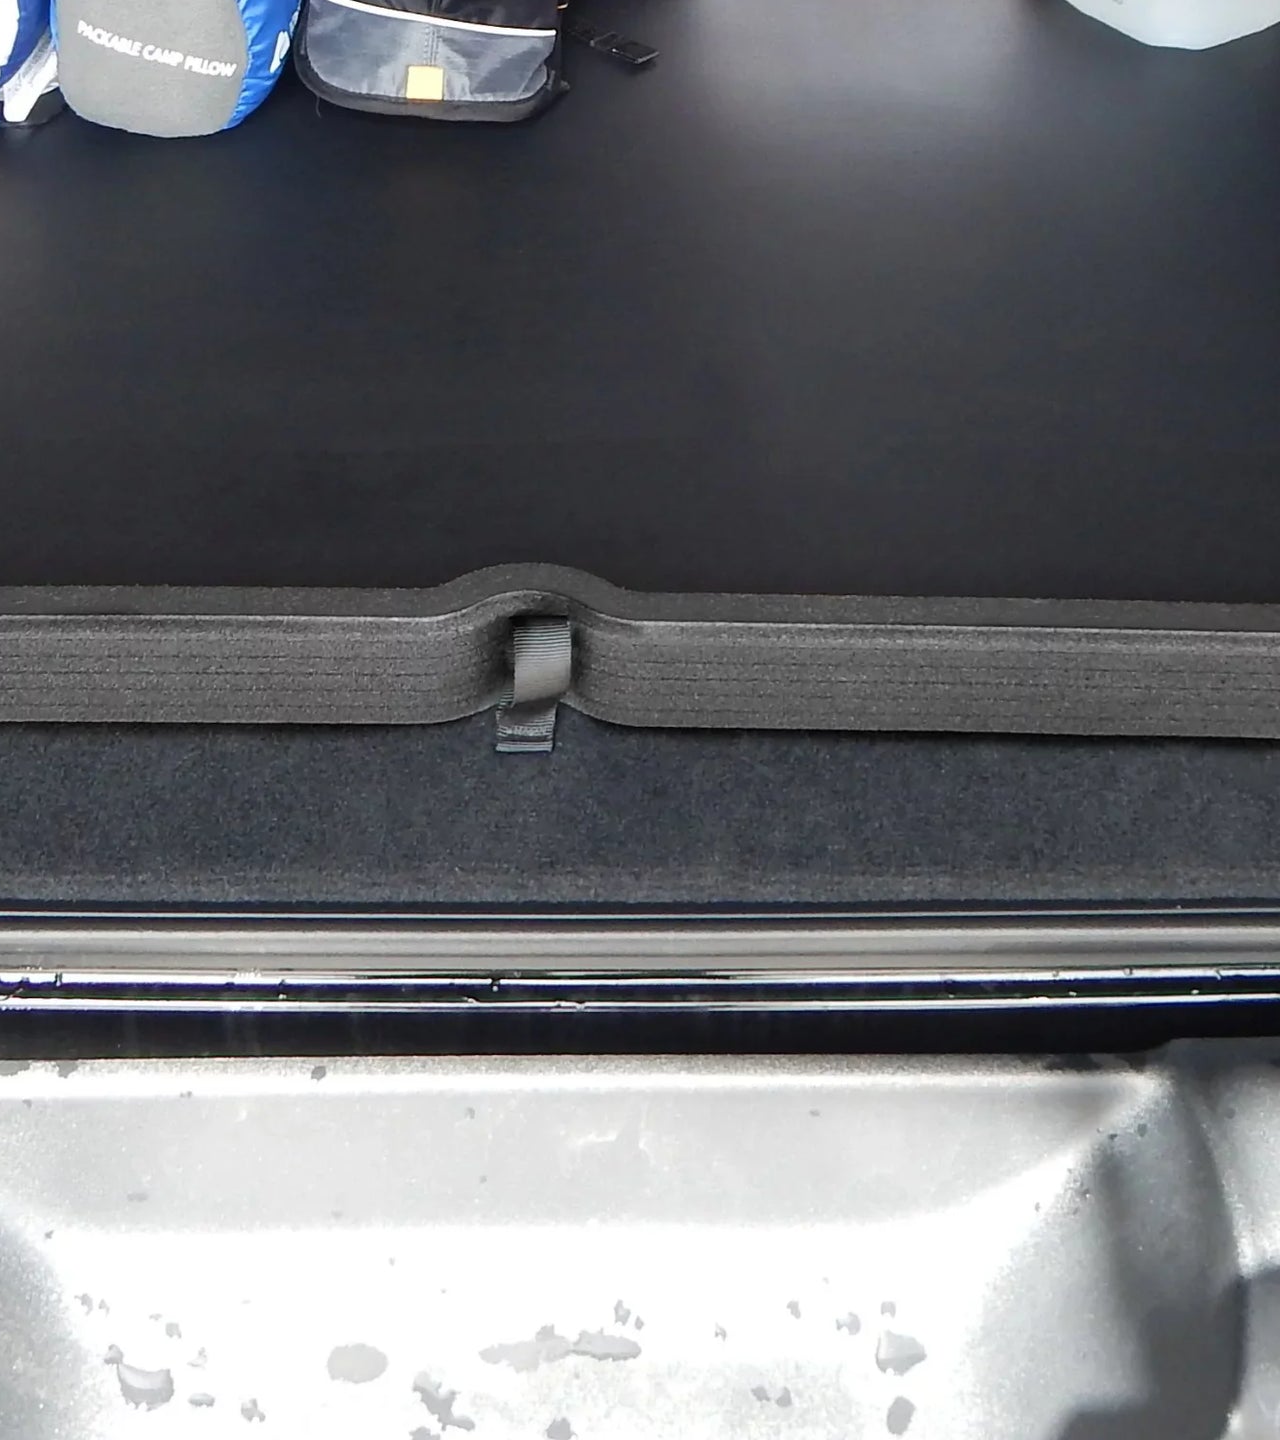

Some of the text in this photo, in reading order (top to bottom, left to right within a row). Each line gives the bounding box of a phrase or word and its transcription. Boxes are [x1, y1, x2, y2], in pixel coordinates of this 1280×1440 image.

[77, 19, 237, 77] PACKABLE CAMP PILLOW
